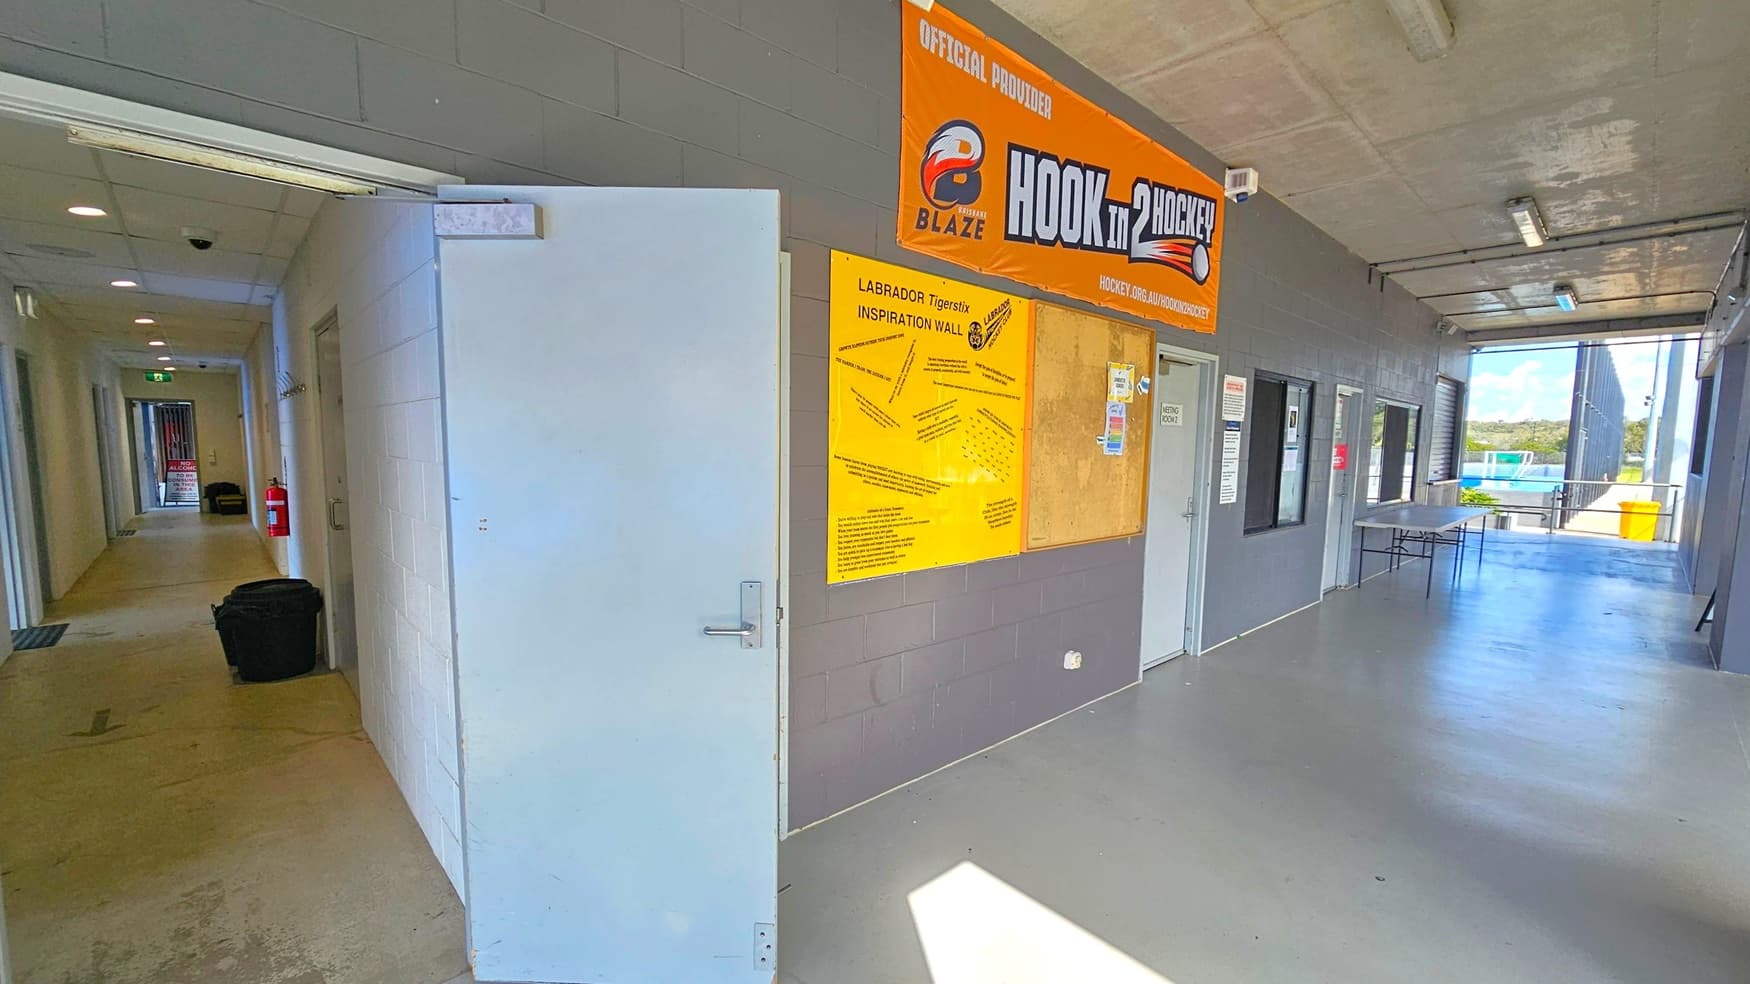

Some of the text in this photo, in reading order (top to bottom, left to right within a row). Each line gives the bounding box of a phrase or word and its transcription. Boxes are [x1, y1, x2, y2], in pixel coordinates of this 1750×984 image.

[919, 18, 1052, 120] OFFICIAL PROVIDER
[1007, 149, 1107, 247] HOOK
[1151, 186, 1217, 244] HOCKEY
[915, 207, 986, 240] BLAZE
[858, 277, 970, 314] LABRADOR Tigerstix
[1099, 275, 1211, 320] HOCKEY.ORG.AU/HOOKIN2HOCKEY
[857, 304, 964, 337] INSPIRATION WALL
